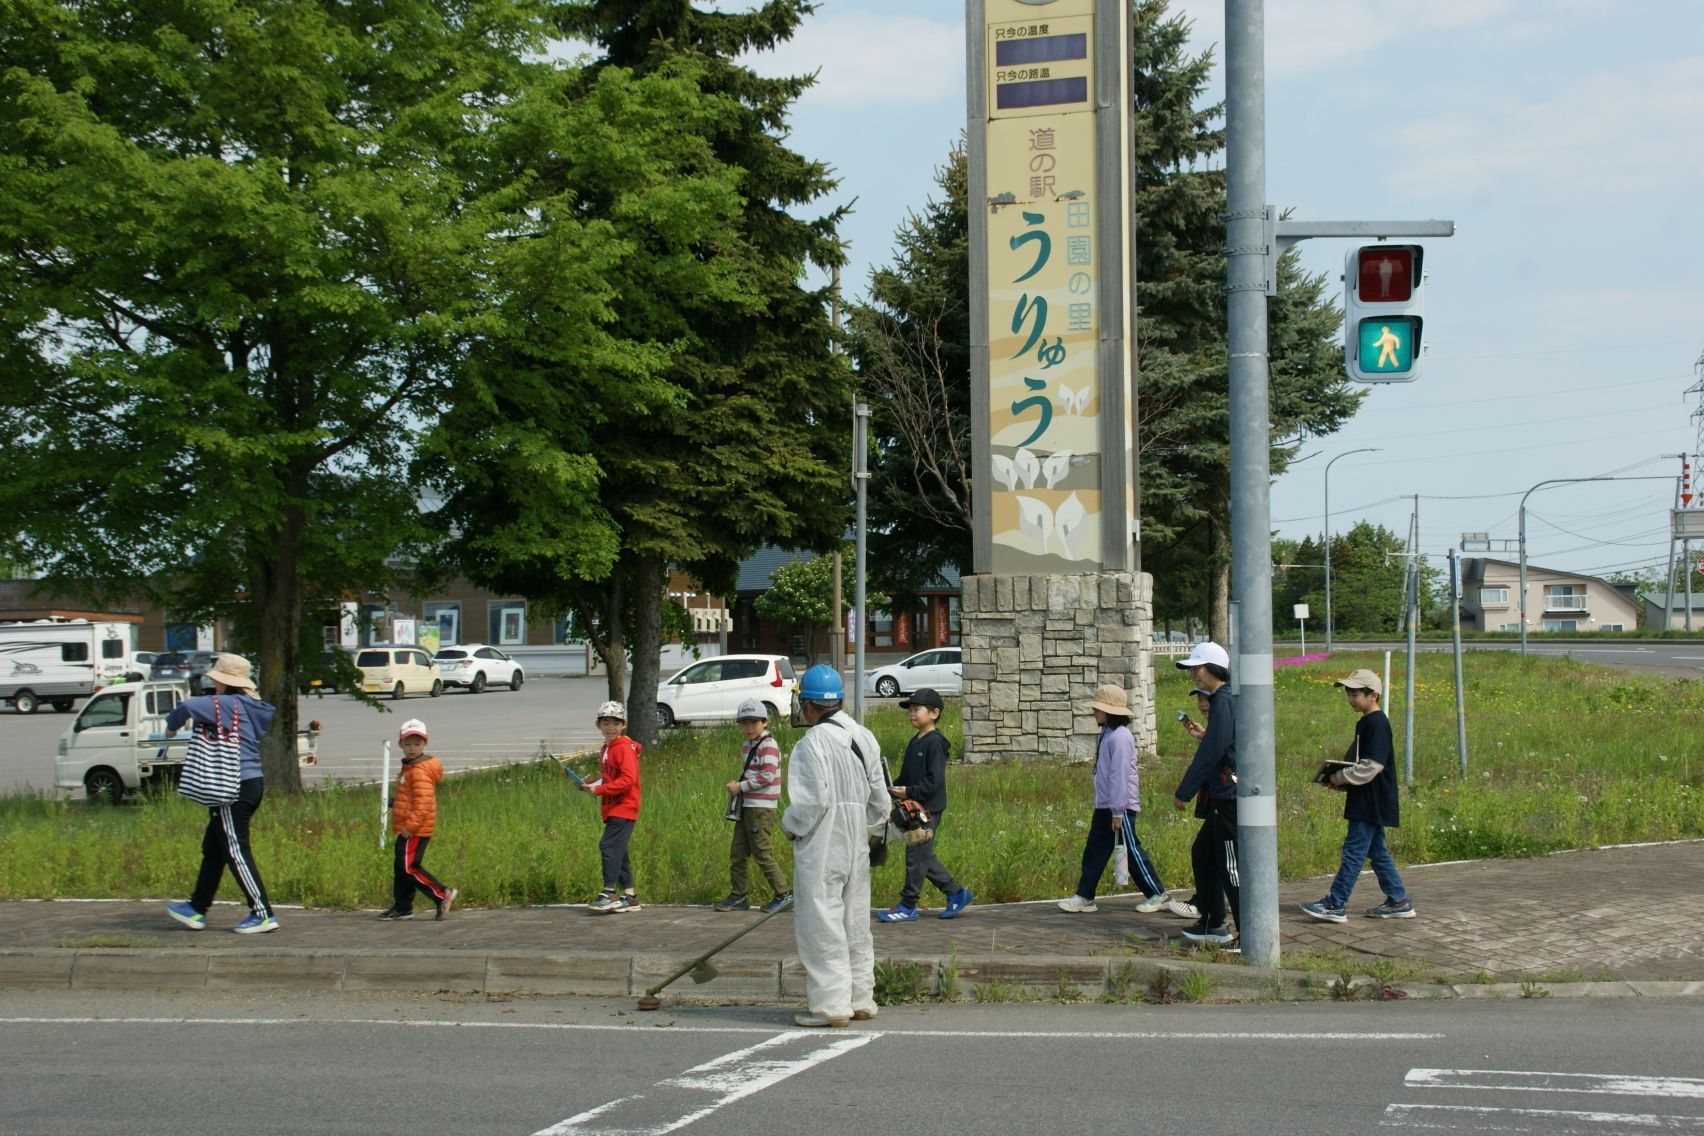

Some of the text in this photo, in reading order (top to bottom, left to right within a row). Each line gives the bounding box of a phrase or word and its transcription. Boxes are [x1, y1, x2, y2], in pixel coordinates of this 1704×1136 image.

[995, 24, 1049, 39] 只今の温度
[996, 68, 1050, 81] 只今の路温
[1029, 127, 1056, 198] 道の駅
[1066, 201, 1093, 332] 田園の里
[1009, 211, 1067, 448] うりゅう
